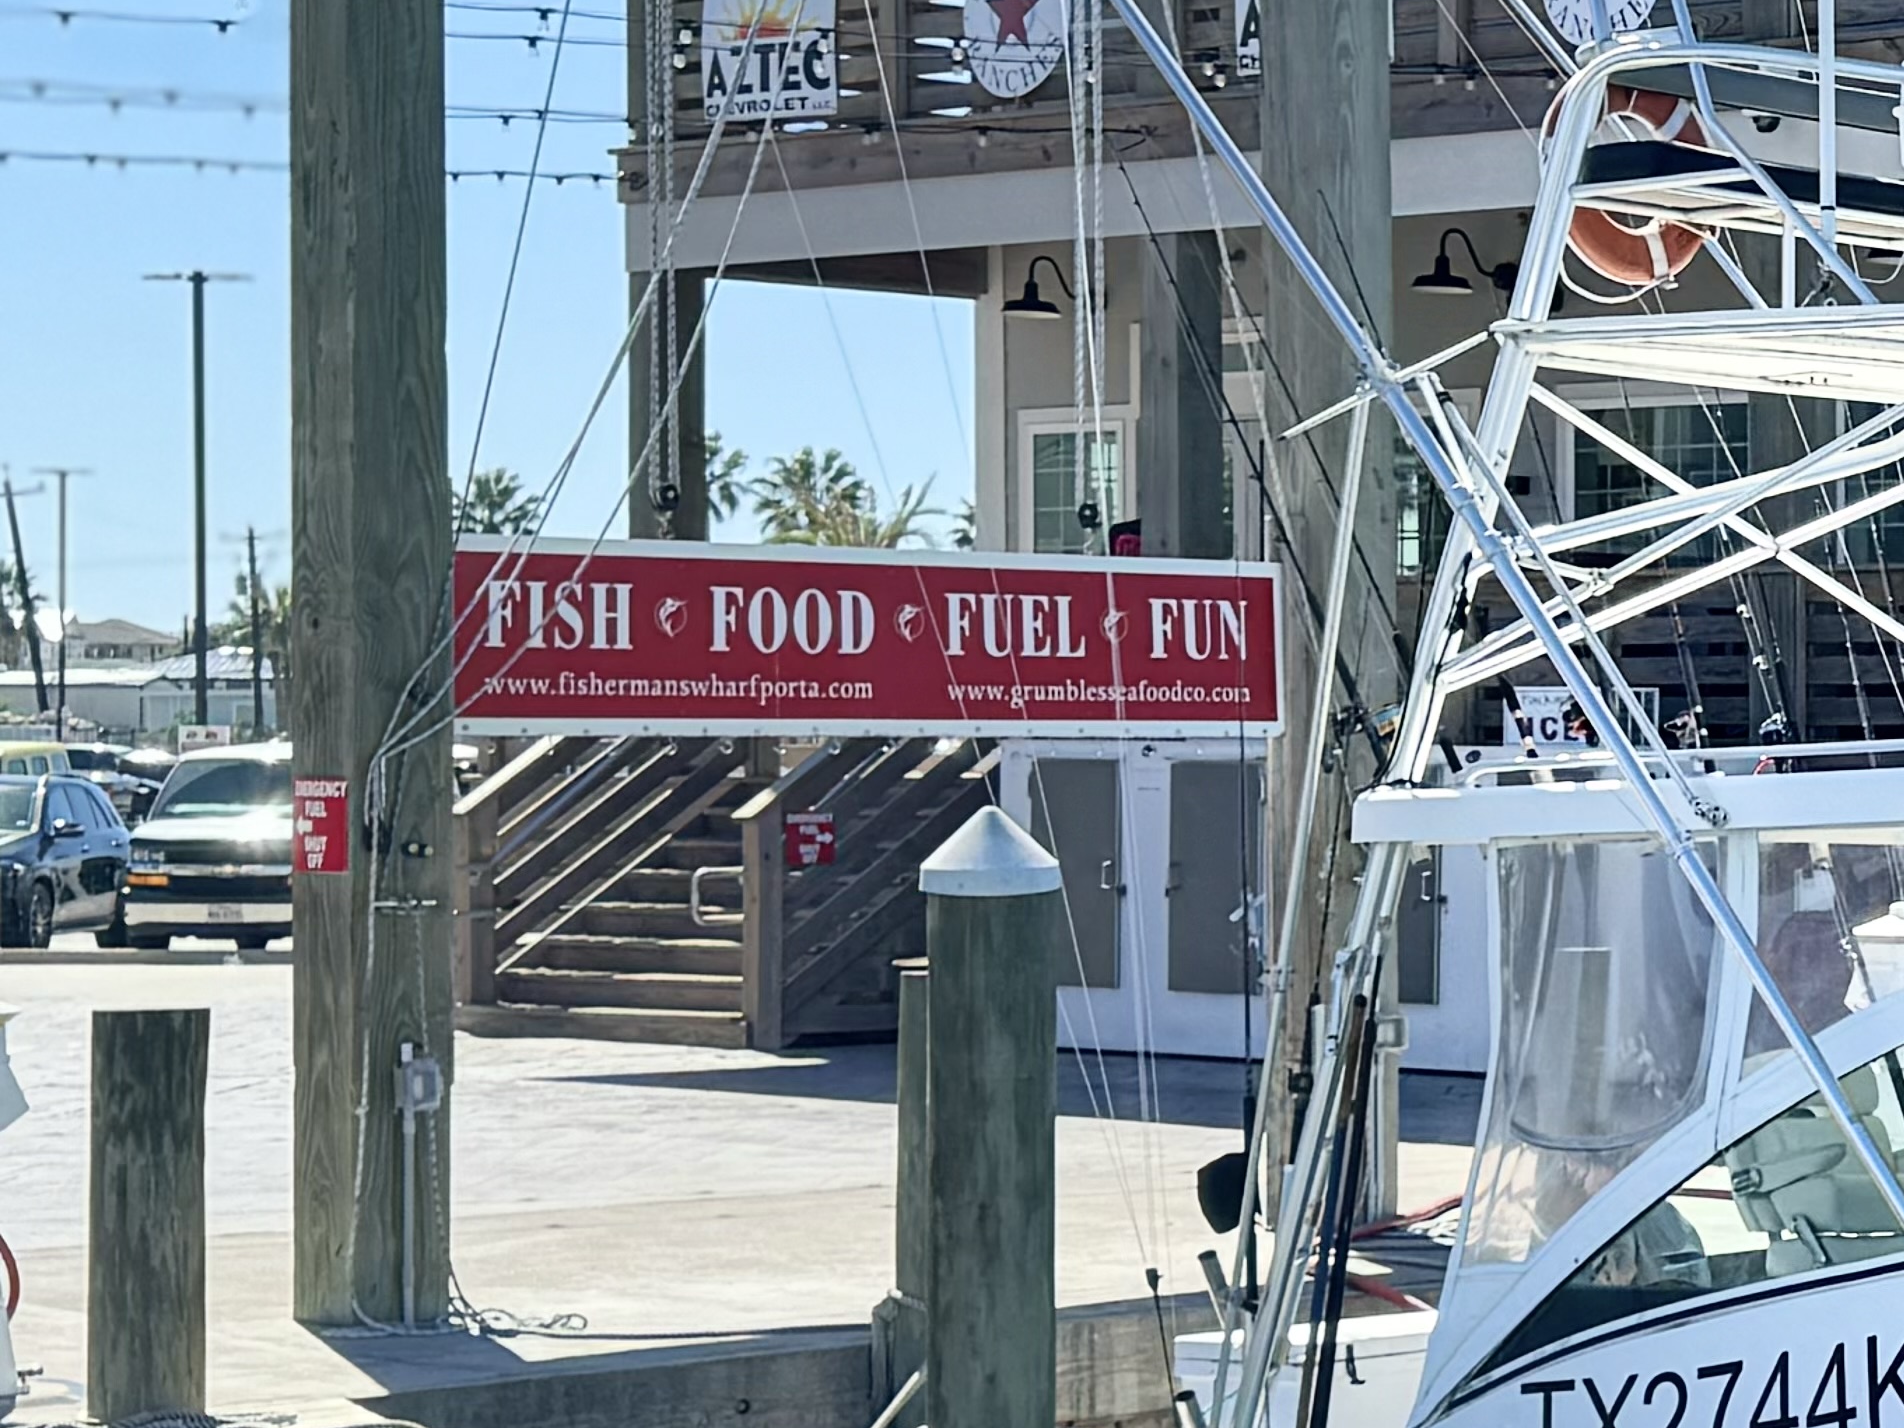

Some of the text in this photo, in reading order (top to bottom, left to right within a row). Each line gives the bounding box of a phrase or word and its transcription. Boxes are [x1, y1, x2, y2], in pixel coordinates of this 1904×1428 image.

[483, 579, 1249, 662] FISH FOOD FUEL FUN
[483, 670, 874, 706] www.fishermanswharfporta.com
